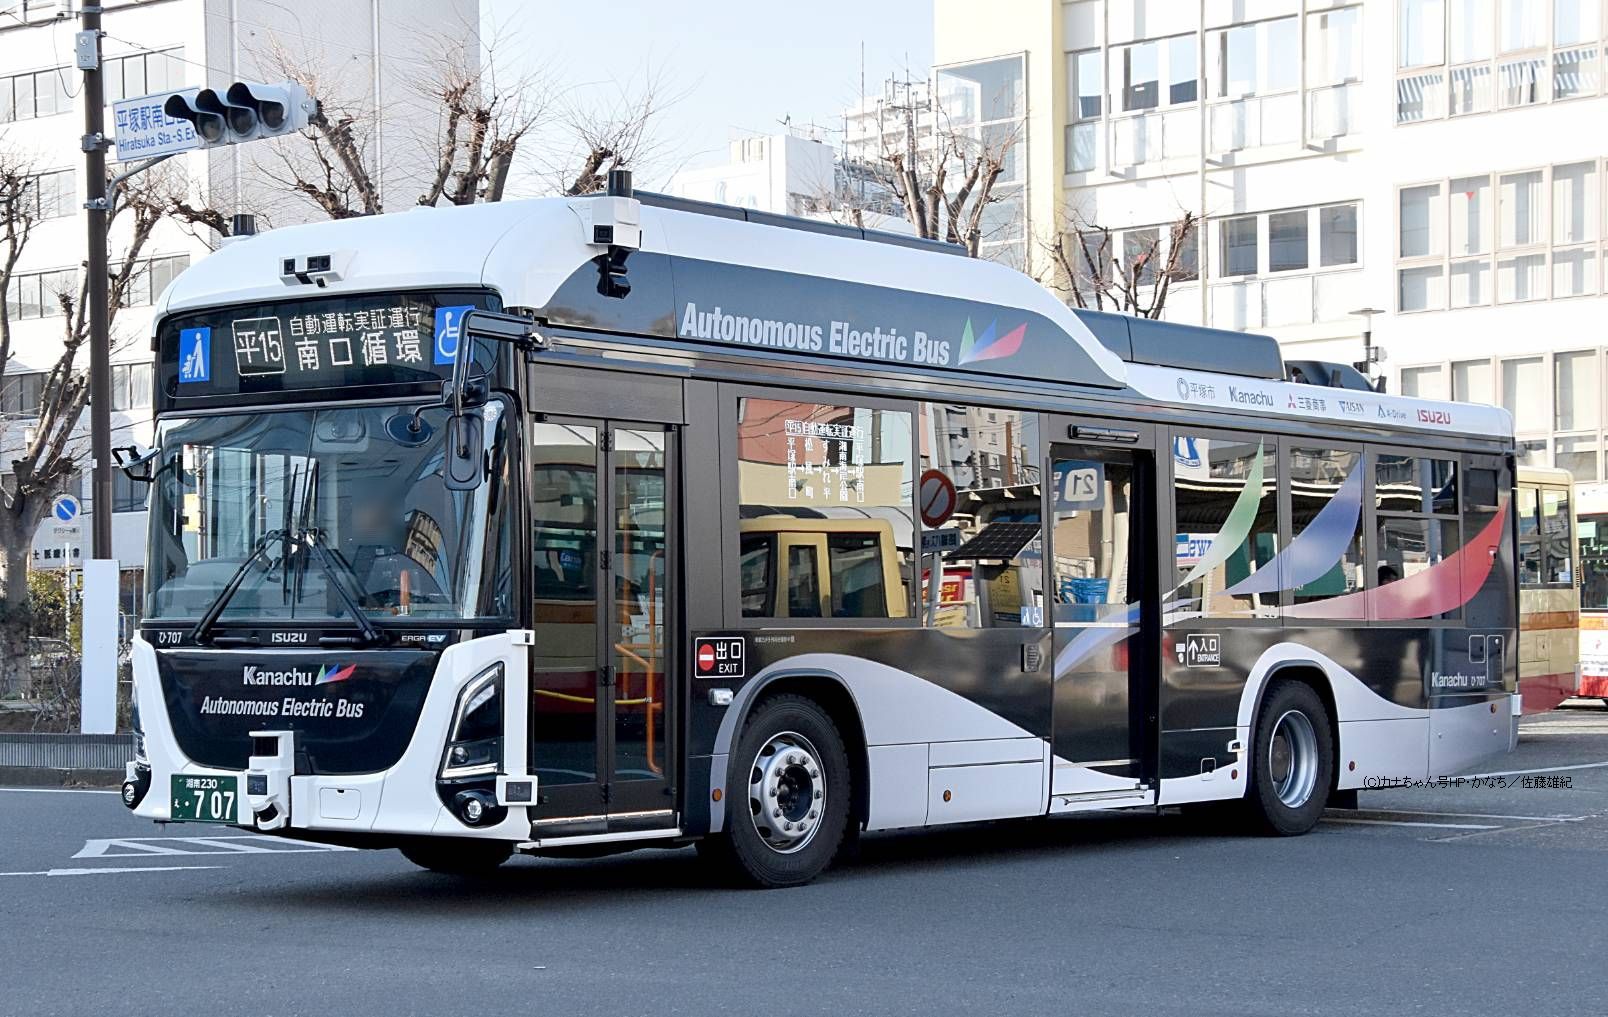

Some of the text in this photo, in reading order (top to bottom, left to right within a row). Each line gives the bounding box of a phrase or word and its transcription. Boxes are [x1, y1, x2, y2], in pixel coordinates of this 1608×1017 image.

[117, 104, 187, 134] 平塚駅南口
[120, 135, 155, 152] Hiratsuka
[186, 127, 196, 140] Ex
[289, 307, 420, 336] 自動運転実証運行
[680, 302, 950, 366] Autonomous Electric Bus
[236, 330, 282, 364] 平15
[295, 329, 422, 371] 南口循環
[1189, 382, 1215, 400] 平塚市
[1228, 385, 1274, 406] Kanachu
[1297, 396, 1327, 412] 三菱商事
[1416, 409, 1451, 425] ISUZU
[271, 632, 307, 643] ISUZU
[427, 634, 447, 643] EV
[1200, 637, 1217, 652] 入口
[716, 641, 741, 660] 出口
[1197, 653, 1220, 662] ENTRANCE
[243, 666, 312, 686] Kanachu
[718, 663, 739, 673] EXIT
[1431, 671, 1468, 687] Kanachu
[200, 695, 364, 718] Autonomous Electric Bus
